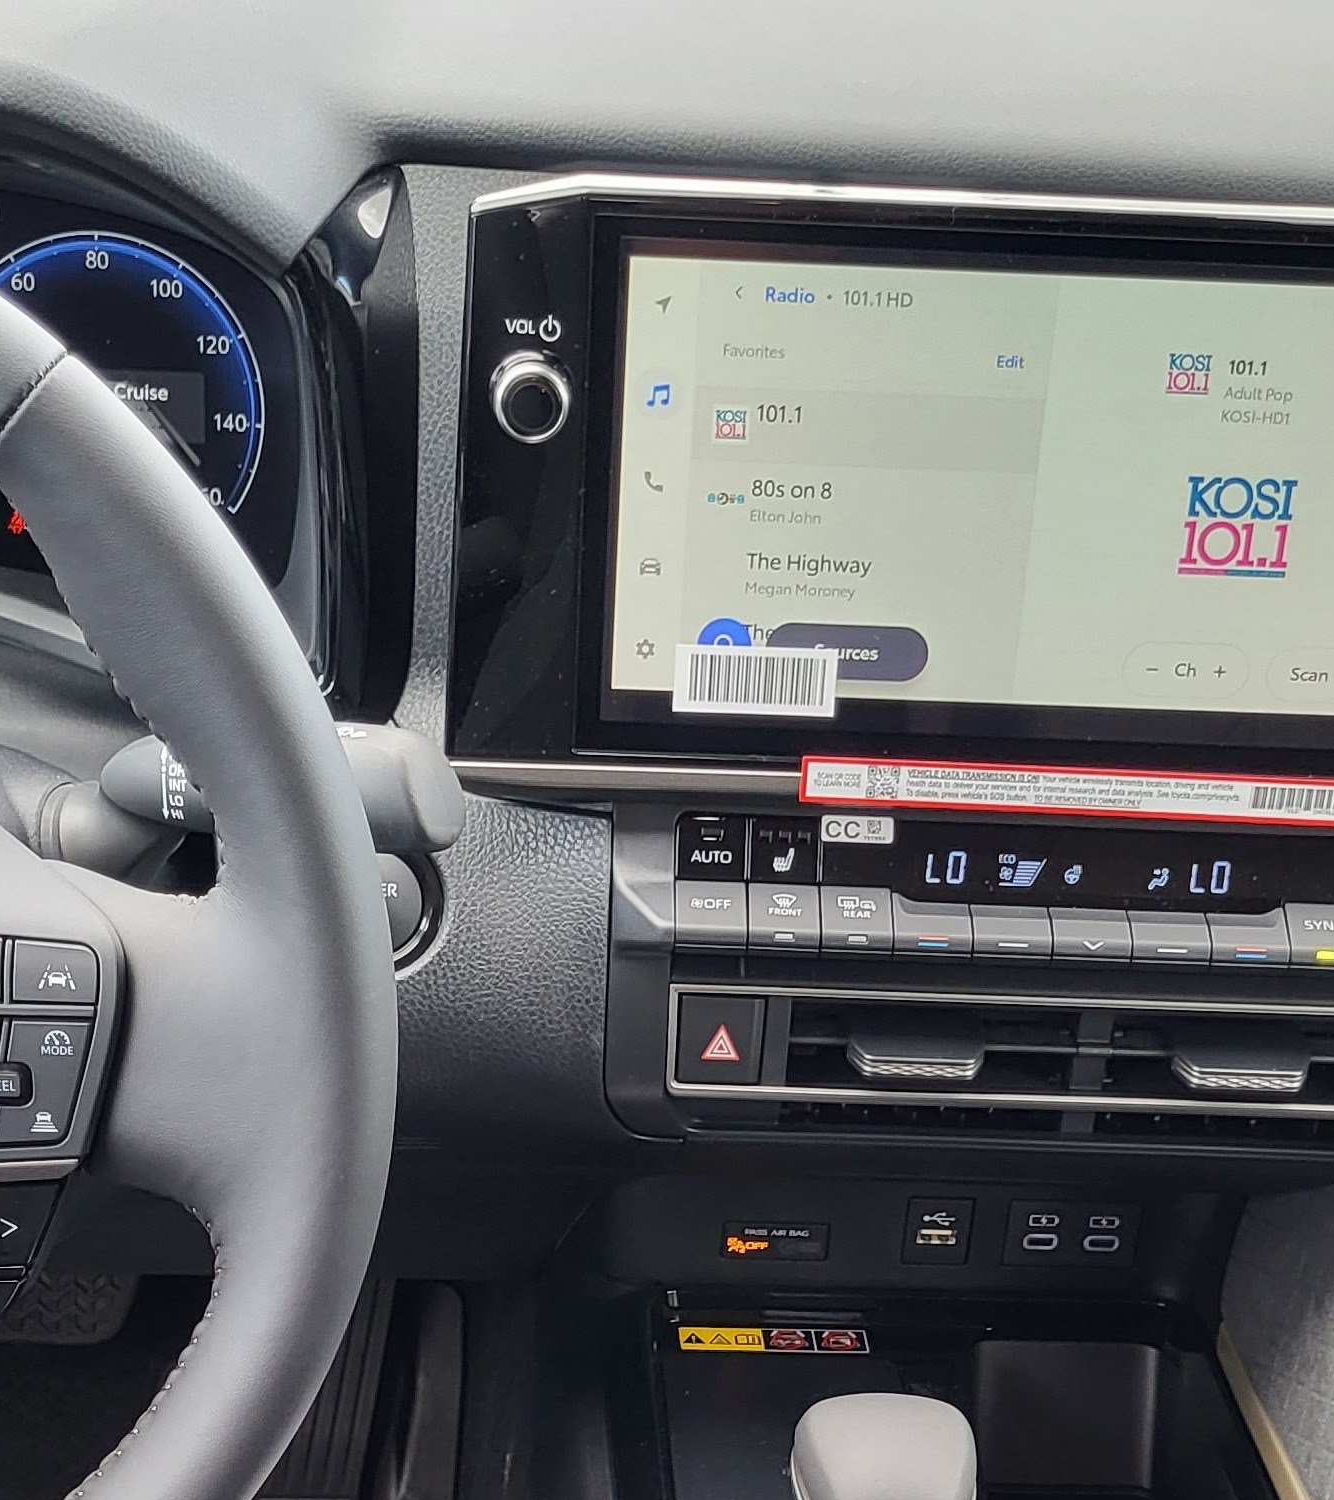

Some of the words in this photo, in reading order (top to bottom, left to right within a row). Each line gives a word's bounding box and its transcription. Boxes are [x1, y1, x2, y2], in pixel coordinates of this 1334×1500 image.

[85, 251, 109, 269] 80
[11, 273, 35, 292] 60
[150, 279, 183, 299] 100
[765, 286, 815, 304] Radio
[843, 290, 882, 308] 101.1
[886, 291, 913, 309] HD
[505, 319, 536, 336] VOL
[197, 335, 229, 354] 120
[723, 344, 785, 360] Favorites
[997, 355, 1024, 370] Edit
[1169, 353, 1212, 372] KOSI
[1228, 360, 1268, 377] 101.1
[1167, 373, 1210, 393] 101.1
[114, 385, 169, 401] Cruise
[1223, 386, 1263, 403] Adult
[1267, 388, 1293, 405] Pop
[214, 413, 247, 432] 140
[715, 410, 747, 424] KOSI
[757, 405, 802, 424] 101.1
[1220, 409, 1291, 426] KOSI-HD1
[752, 480, 785, 499] 80s
[790, 486, 816, 499] on
[820, 482, 832, 499] 8
[1187, 476, 1298, 521] KOSI
[750, 509, 785, 524] Elton
[788, 510, 821, 525] John
[1179, 521, 1289, 568] 101.1
[747, 553, 781, 572] The
[786, 554, 872, 579] Highway
[745, 581, 790, 599] Megan
[795, 583, 855, 602] Moroney
[814, 643, 879, 662] urces
[1174, 661, 1197, 679] Ch
[1290, 666, 1329, 684] Scan
[169, 778, 187, 792] INT
[169, 794, 184, 807] LO
[170, 808, 184, 820] HI
[825, 820, 861, 838] CC
[690, 850, 732, 864] AUTO
[999, 853, 1016, 864] ECO
[925, 850, 967, 885] LO
[1189, 860, 1232, 894] LO
[704, 898, 732, 910] OFF
[768, 906, 802, 917] FRONT
[843, 909, 871, 918] REAR
[41, 1045, 74, 1056] MODE
[771, 1229, 787, 1237] AIR
[788, 1229, 810, 1238] BAG
